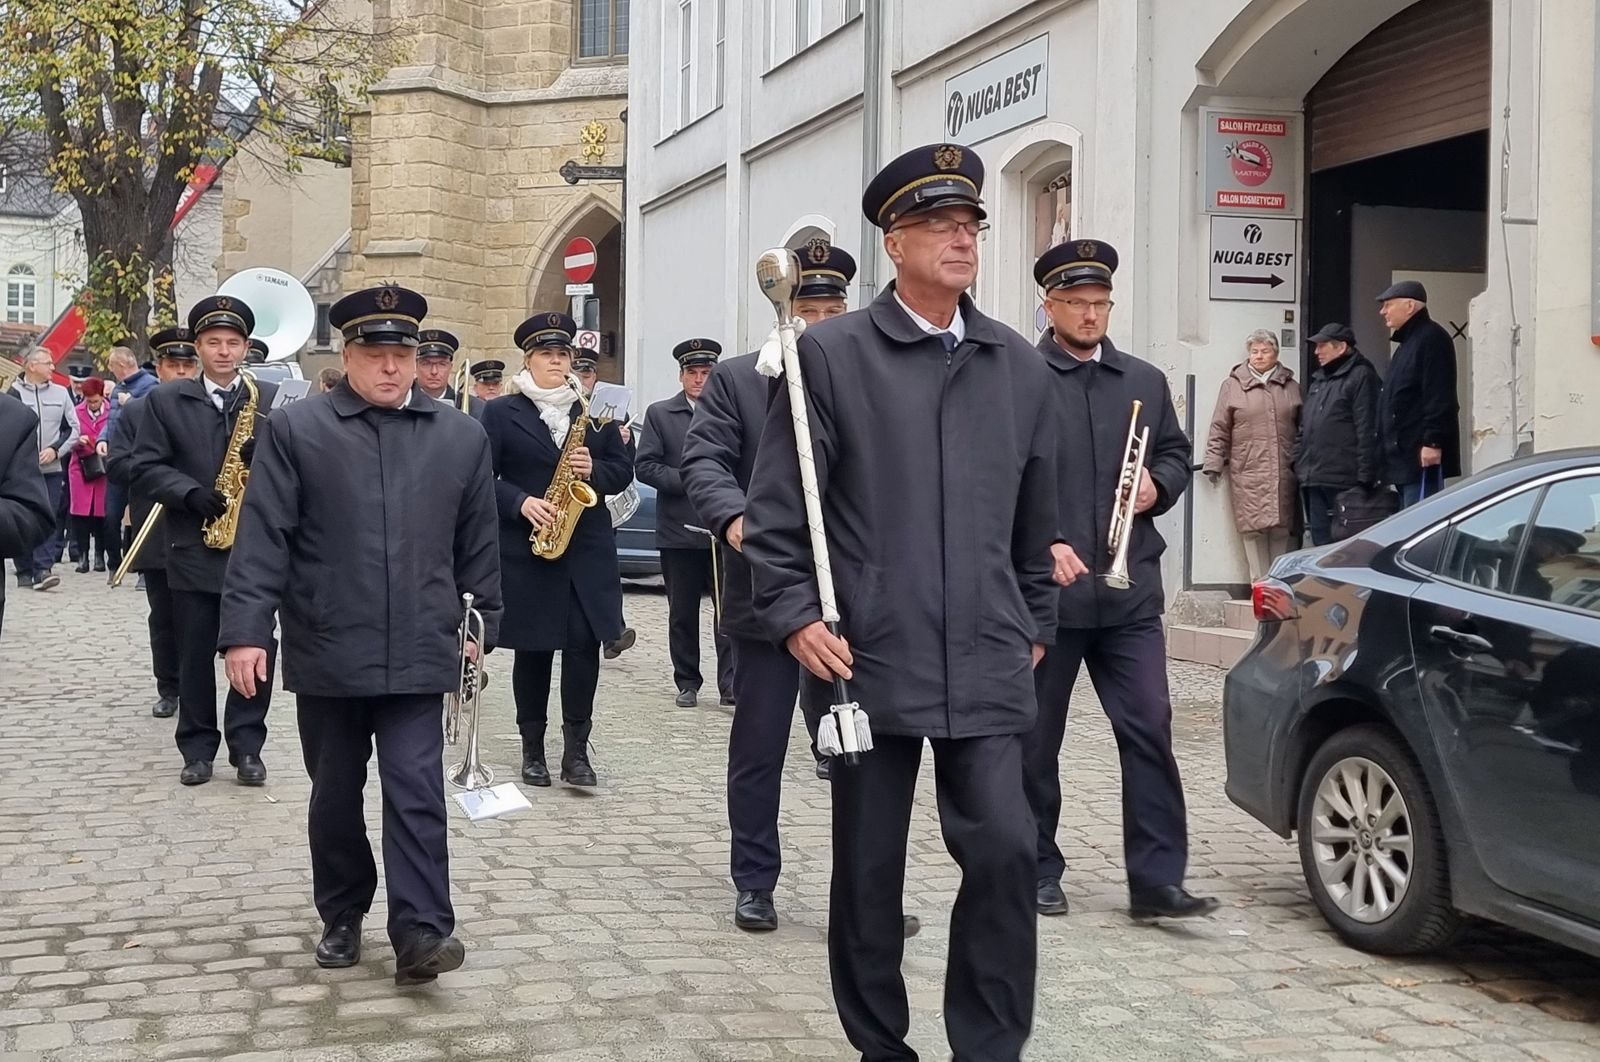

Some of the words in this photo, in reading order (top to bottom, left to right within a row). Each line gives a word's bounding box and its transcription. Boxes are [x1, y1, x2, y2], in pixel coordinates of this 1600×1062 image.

[965, 81, 1001, 124] NUGA
[1003, 63, 1042, 108] BEST
[1220, 121, 1243, 131] SALON
[1244, 122, 1283, 133] FRYZJERSKI
[1219, 194, 1239, 204] SALON
[1240, 195, 1282, 206] KOSMETYCZNY
[1213, 250, 1253, 265] NUGA
[1255, 252, 1294, 267] BEST
[264, 275, 289, 288] YAMAHA
